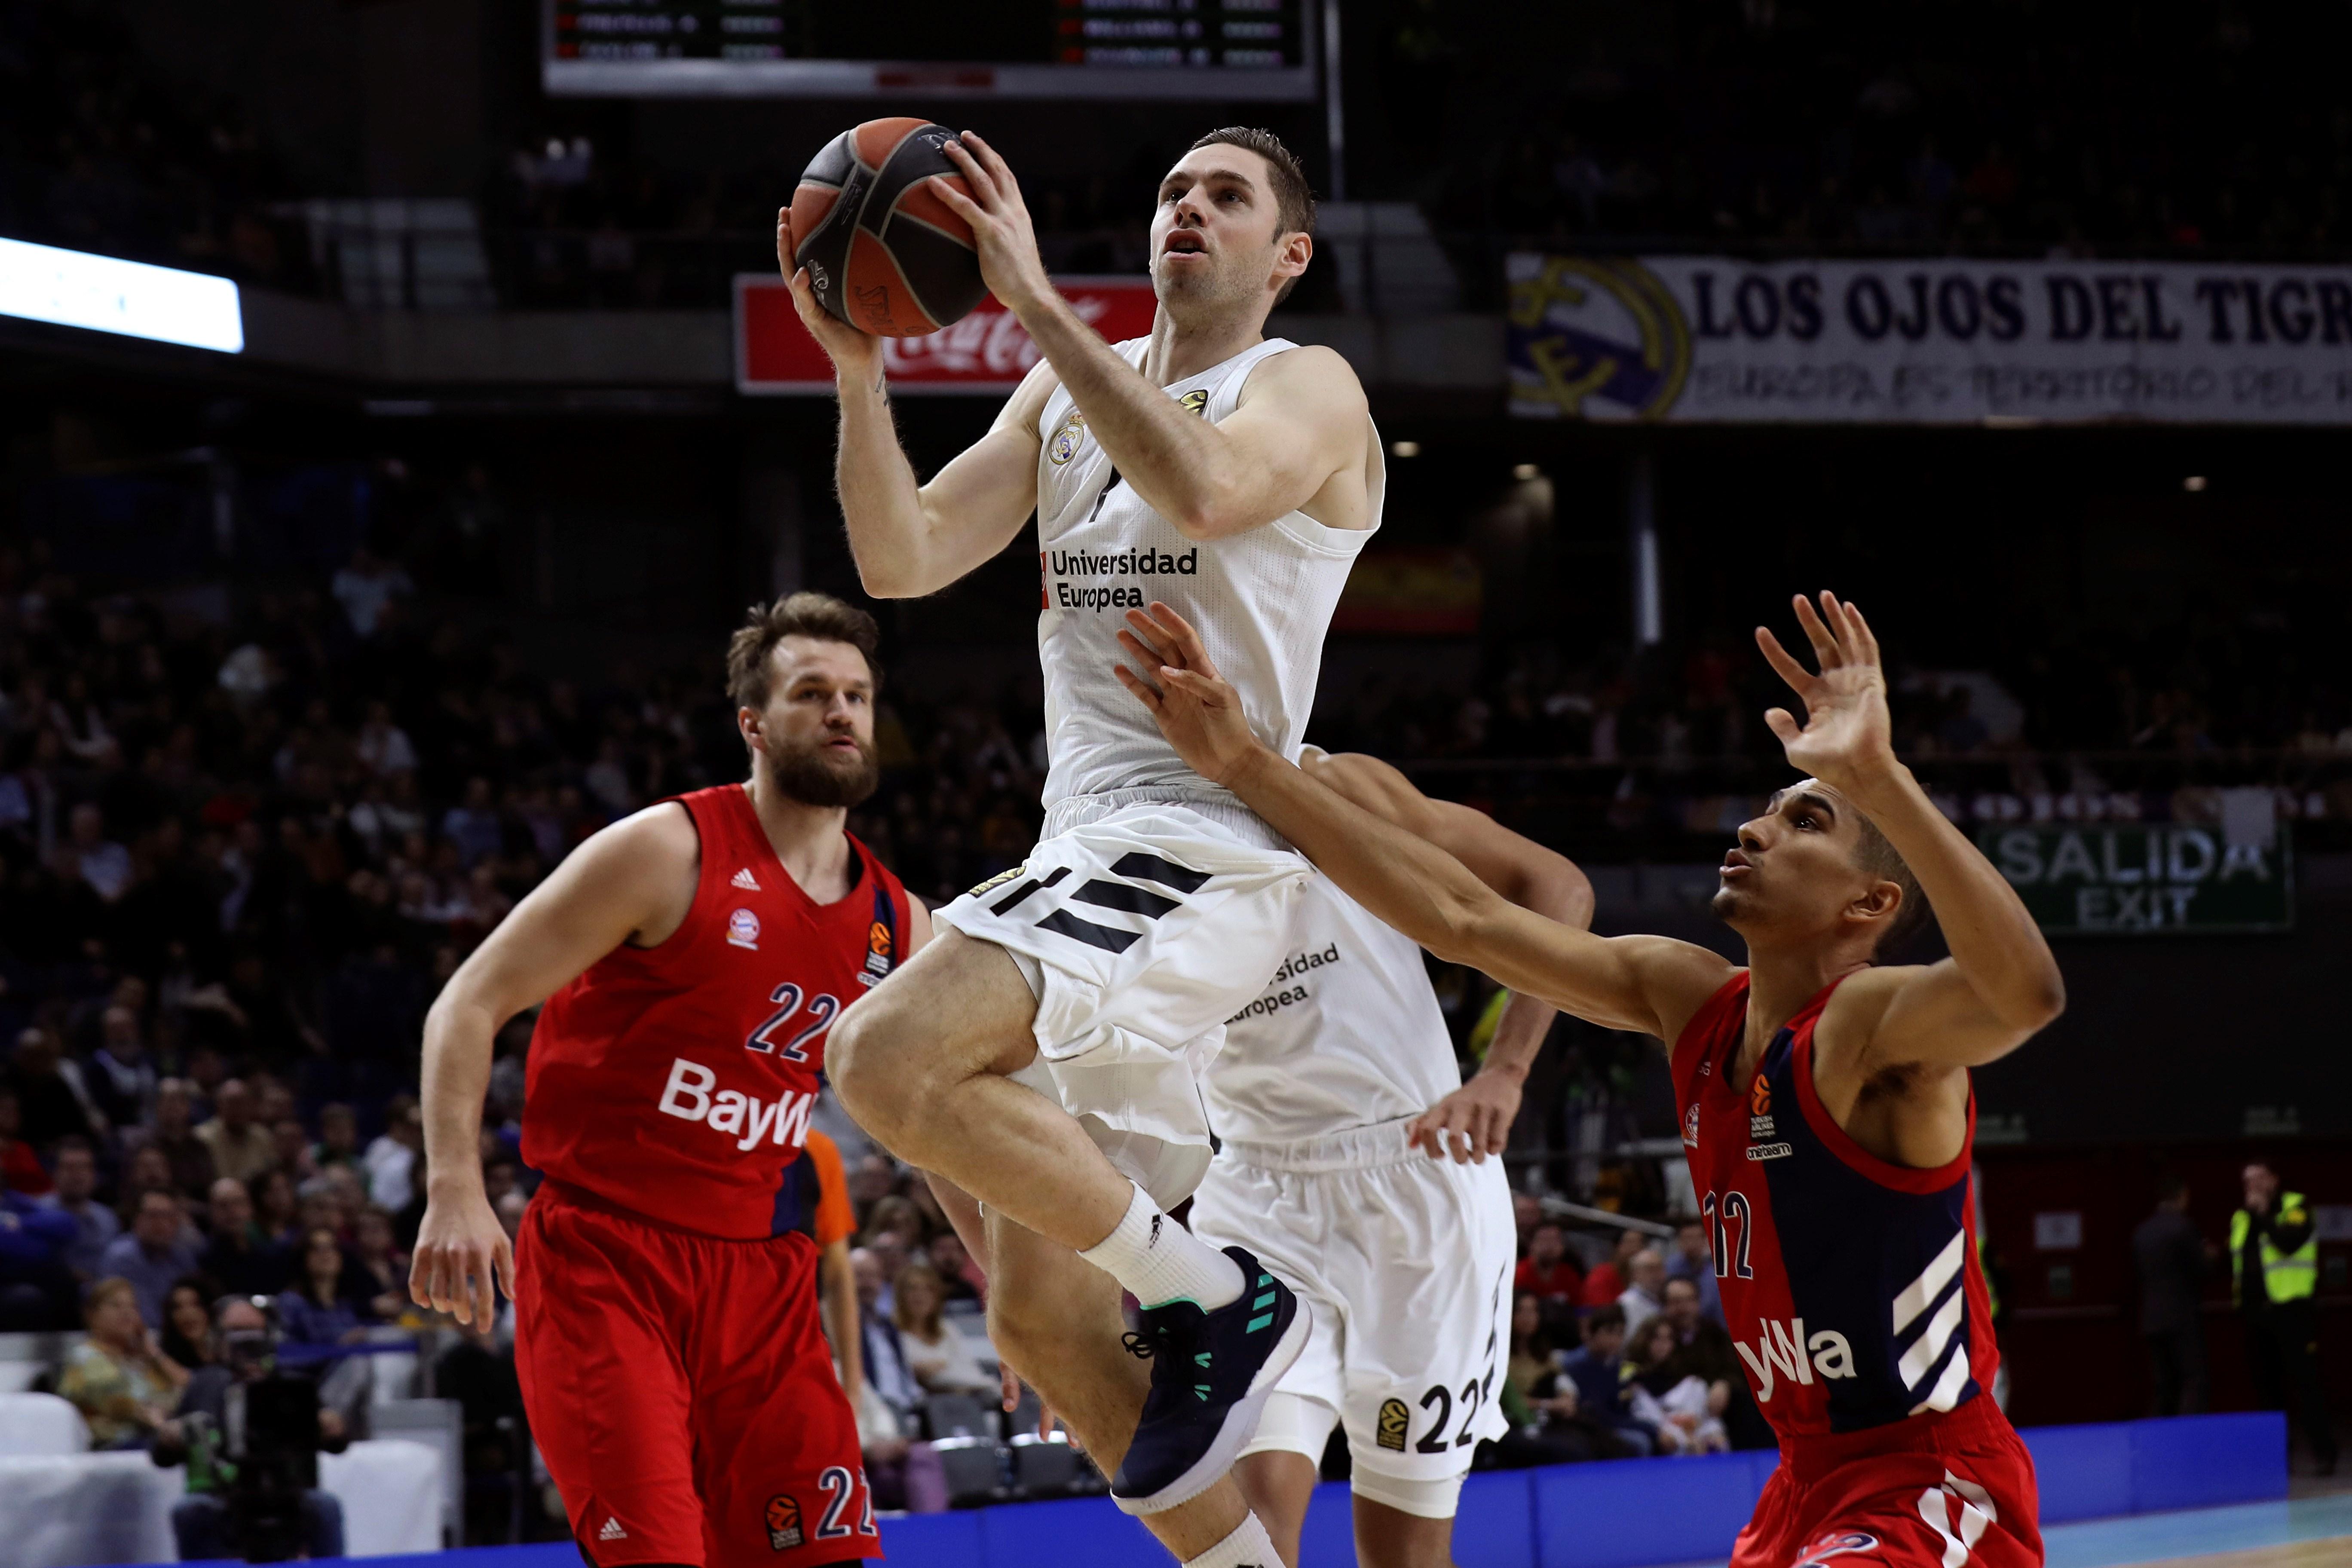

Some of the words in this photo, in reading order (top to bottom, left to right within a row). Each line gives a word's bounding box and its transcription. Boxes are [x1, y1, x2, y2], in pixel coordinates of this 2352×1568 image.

[1694, 273, 1822, 340] LOS
[1847, 274, 2024, 343] OJOS
[2046, 276, 2181, 343] DEL
[1052, 547, 1197, 576] Universidad
[1057, 582, 1144, 613] Europea
[2075, 885, 2198, 932] EXIT
[744, 982, 840, 1063] 22
[1703, 1190, 1753, 1280] 12
[1416, 1378, 1478, 1453] 22
